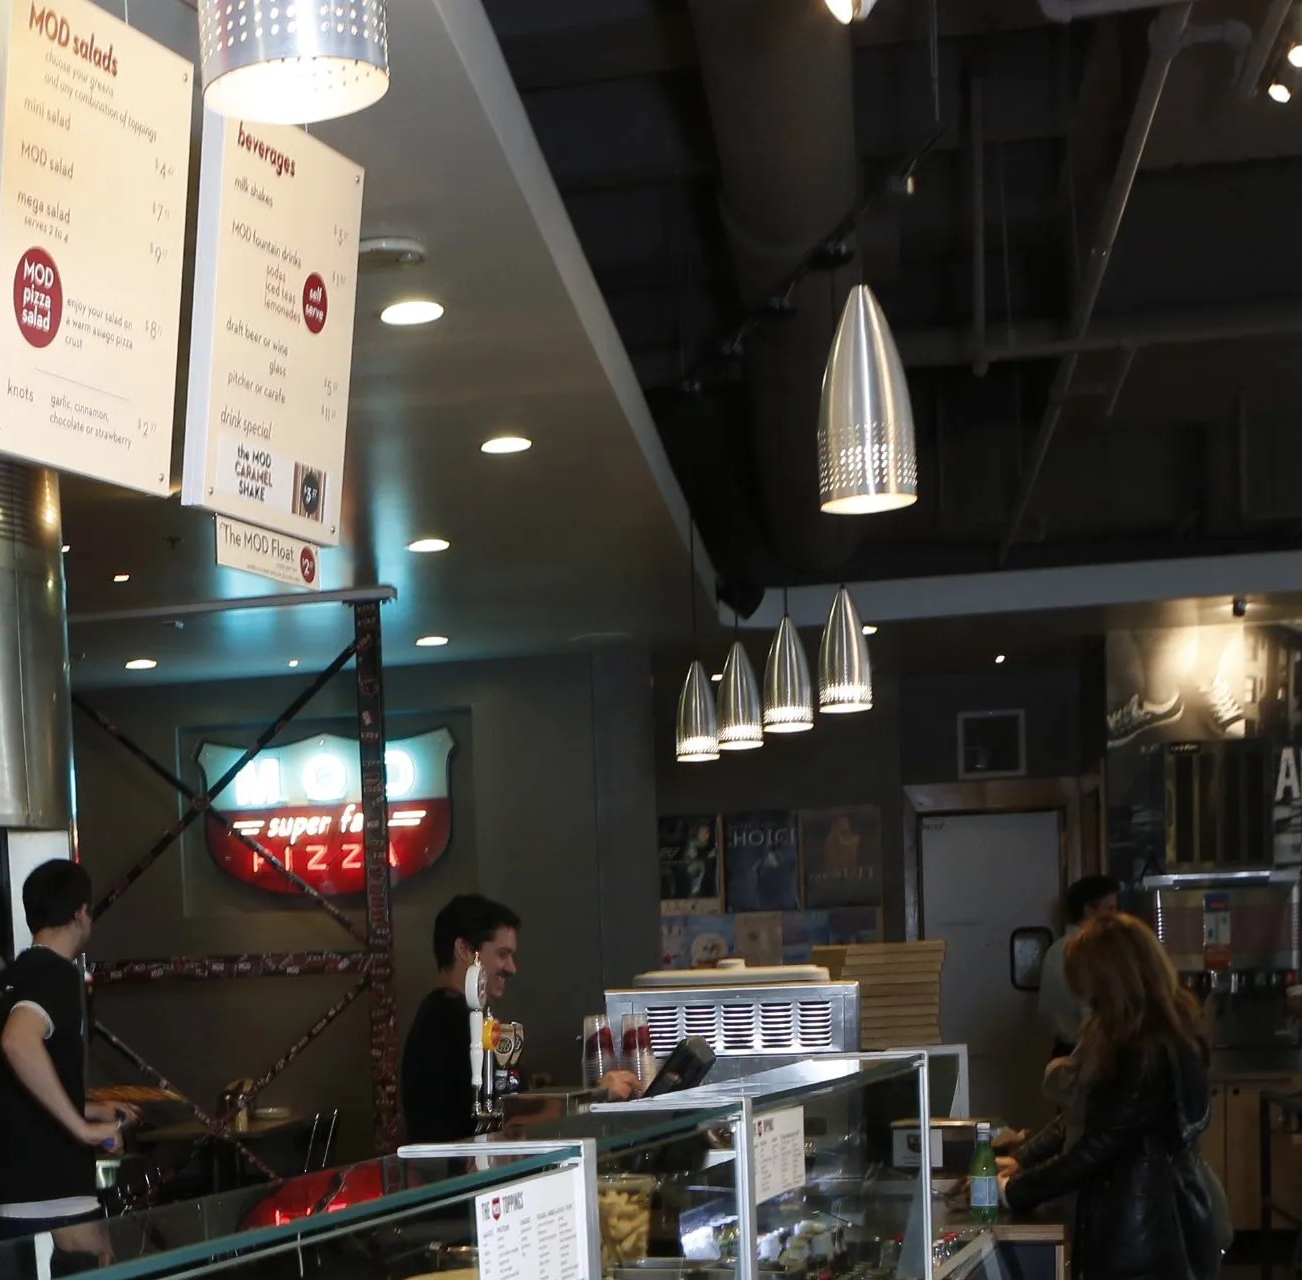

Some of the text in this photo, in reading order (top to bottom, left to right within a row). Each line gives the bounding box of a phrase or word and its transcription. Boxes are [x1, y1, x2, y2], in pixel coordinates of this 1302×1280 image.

[28, 0, 118, 78] MOD salads
[24, 97, 72, 132] mini salad
[21, 143, 74, 180] MOD salad
[238, 120, 297, 178] beverages
[18, 191, 71, 225] mega salad
[232, 218, 252, 242] MOD
[24, 258, 55, 290] MOD
[24, 285, 52, 309] pizza
[22, 308, 51, 334] salad
[226, 319, 289, 358] draft beer wine
[228, 370, 254, 392] pitcher
[269, 359, 287, 378] glass
[7, 378, 35, 403] knots
[50, 412, 132, 451] chocolate strawberry
[221, 405, 273, 440] drink special
[238, 444, 272, 469] the MOD
[235, 461, 273, 488] CARAMEL
[239, 481, 266, 502] SHAKE
[225, 525, 294, 562] The MOD Float
[266, 815, 333, 846] super
[253, 842, 399, 874] PIZZ
